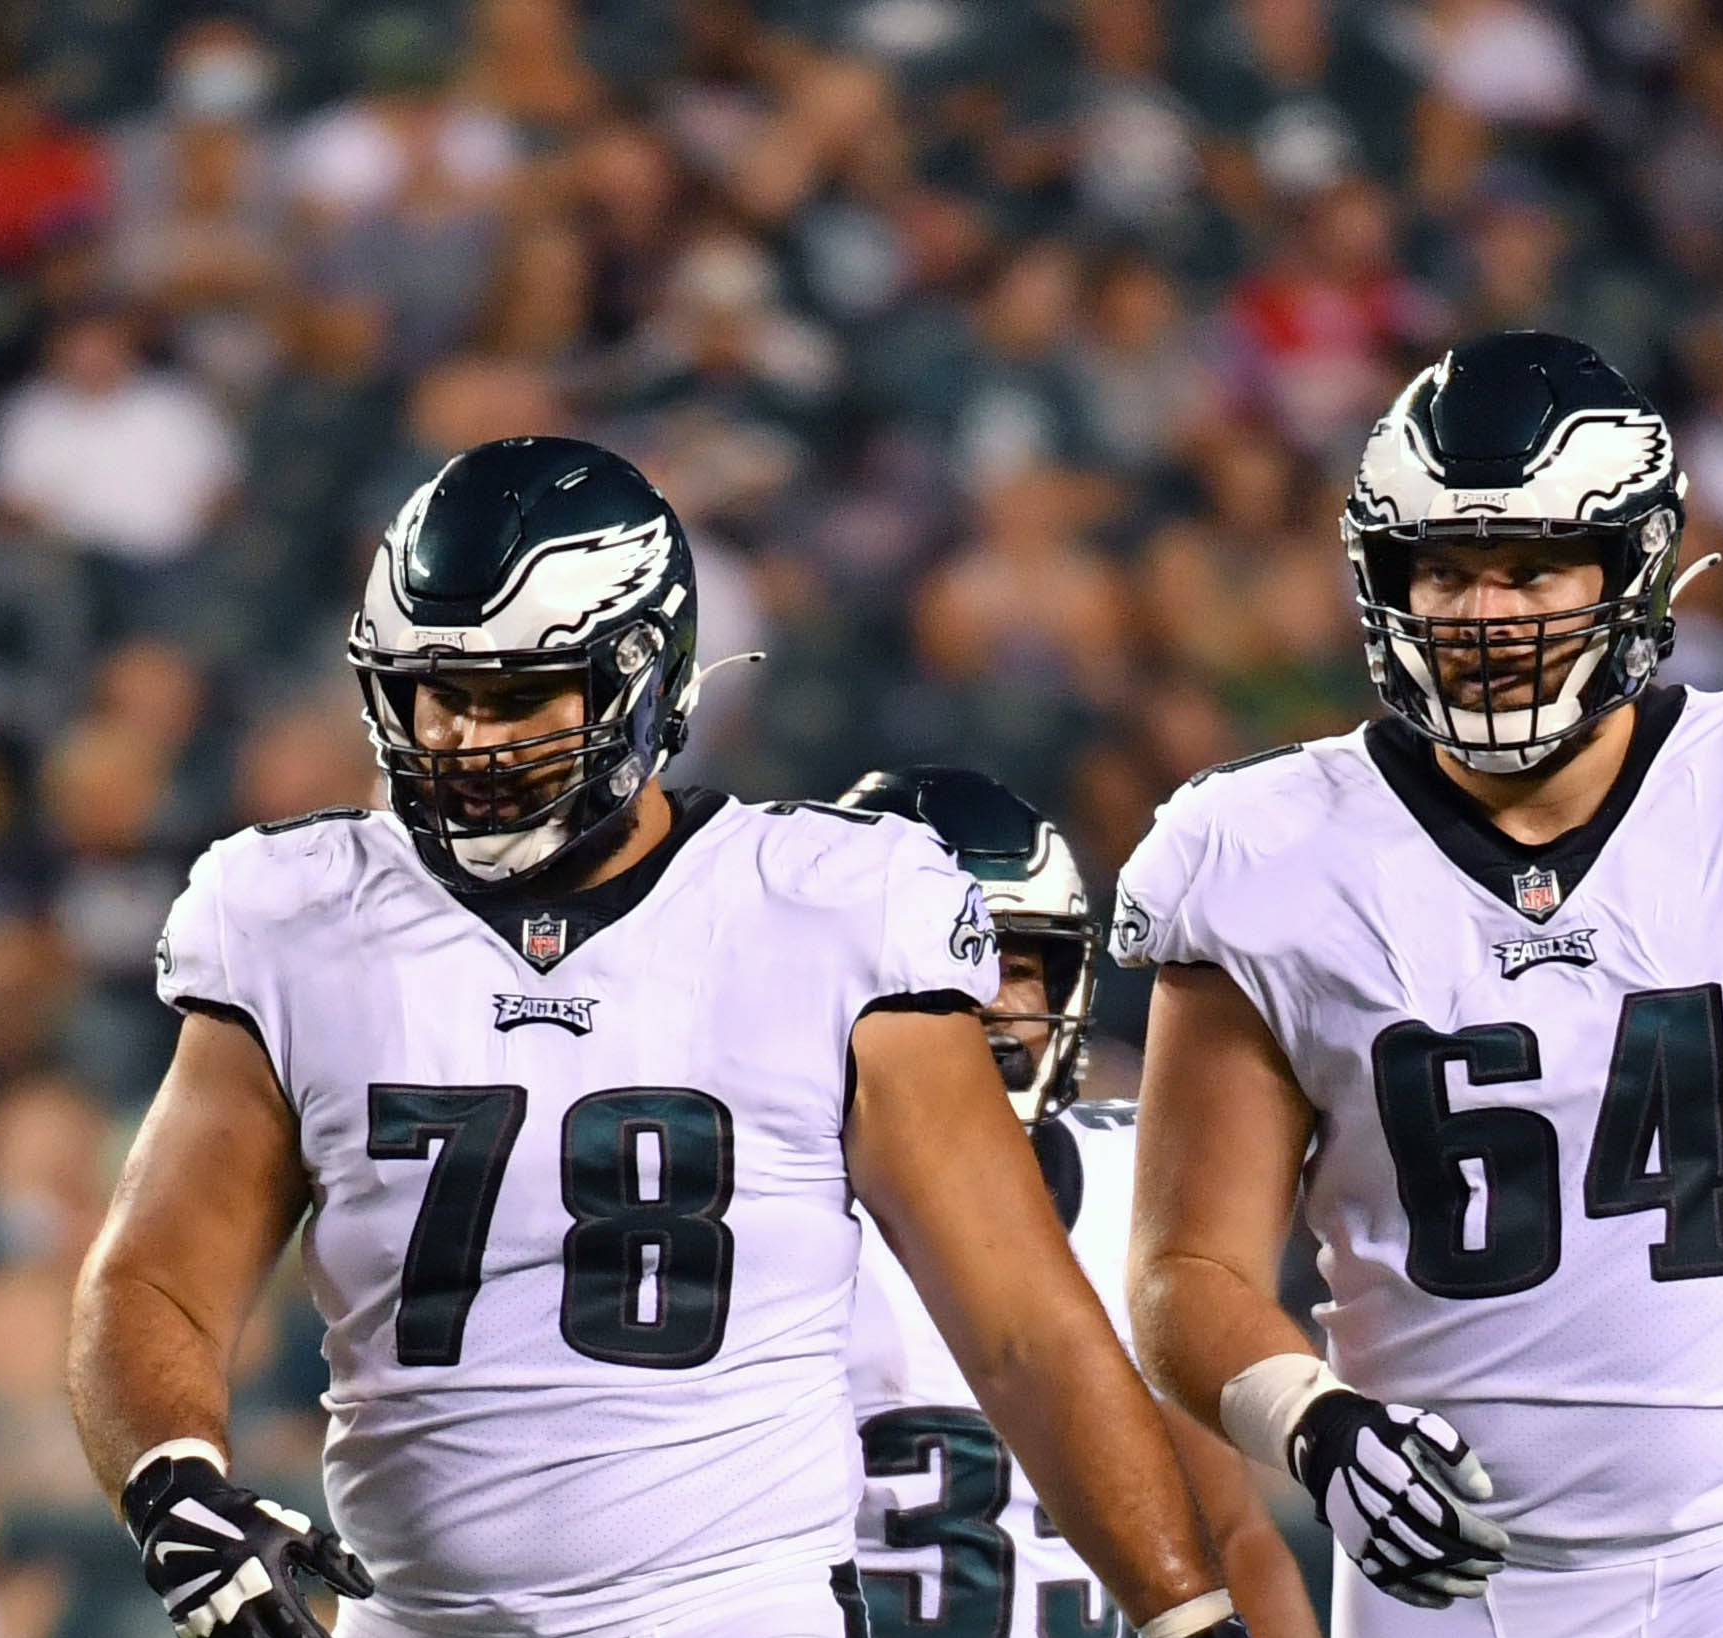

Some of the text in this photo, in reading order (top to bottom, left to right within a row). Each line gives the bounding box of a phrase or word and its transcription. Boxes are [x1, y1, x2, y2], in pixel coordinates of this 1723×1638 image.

[1492, 928, 1598, 980] EAGLES
[492, 994, 600, 1037] EAGLES
[367, 1084, 734, 1369] 78
